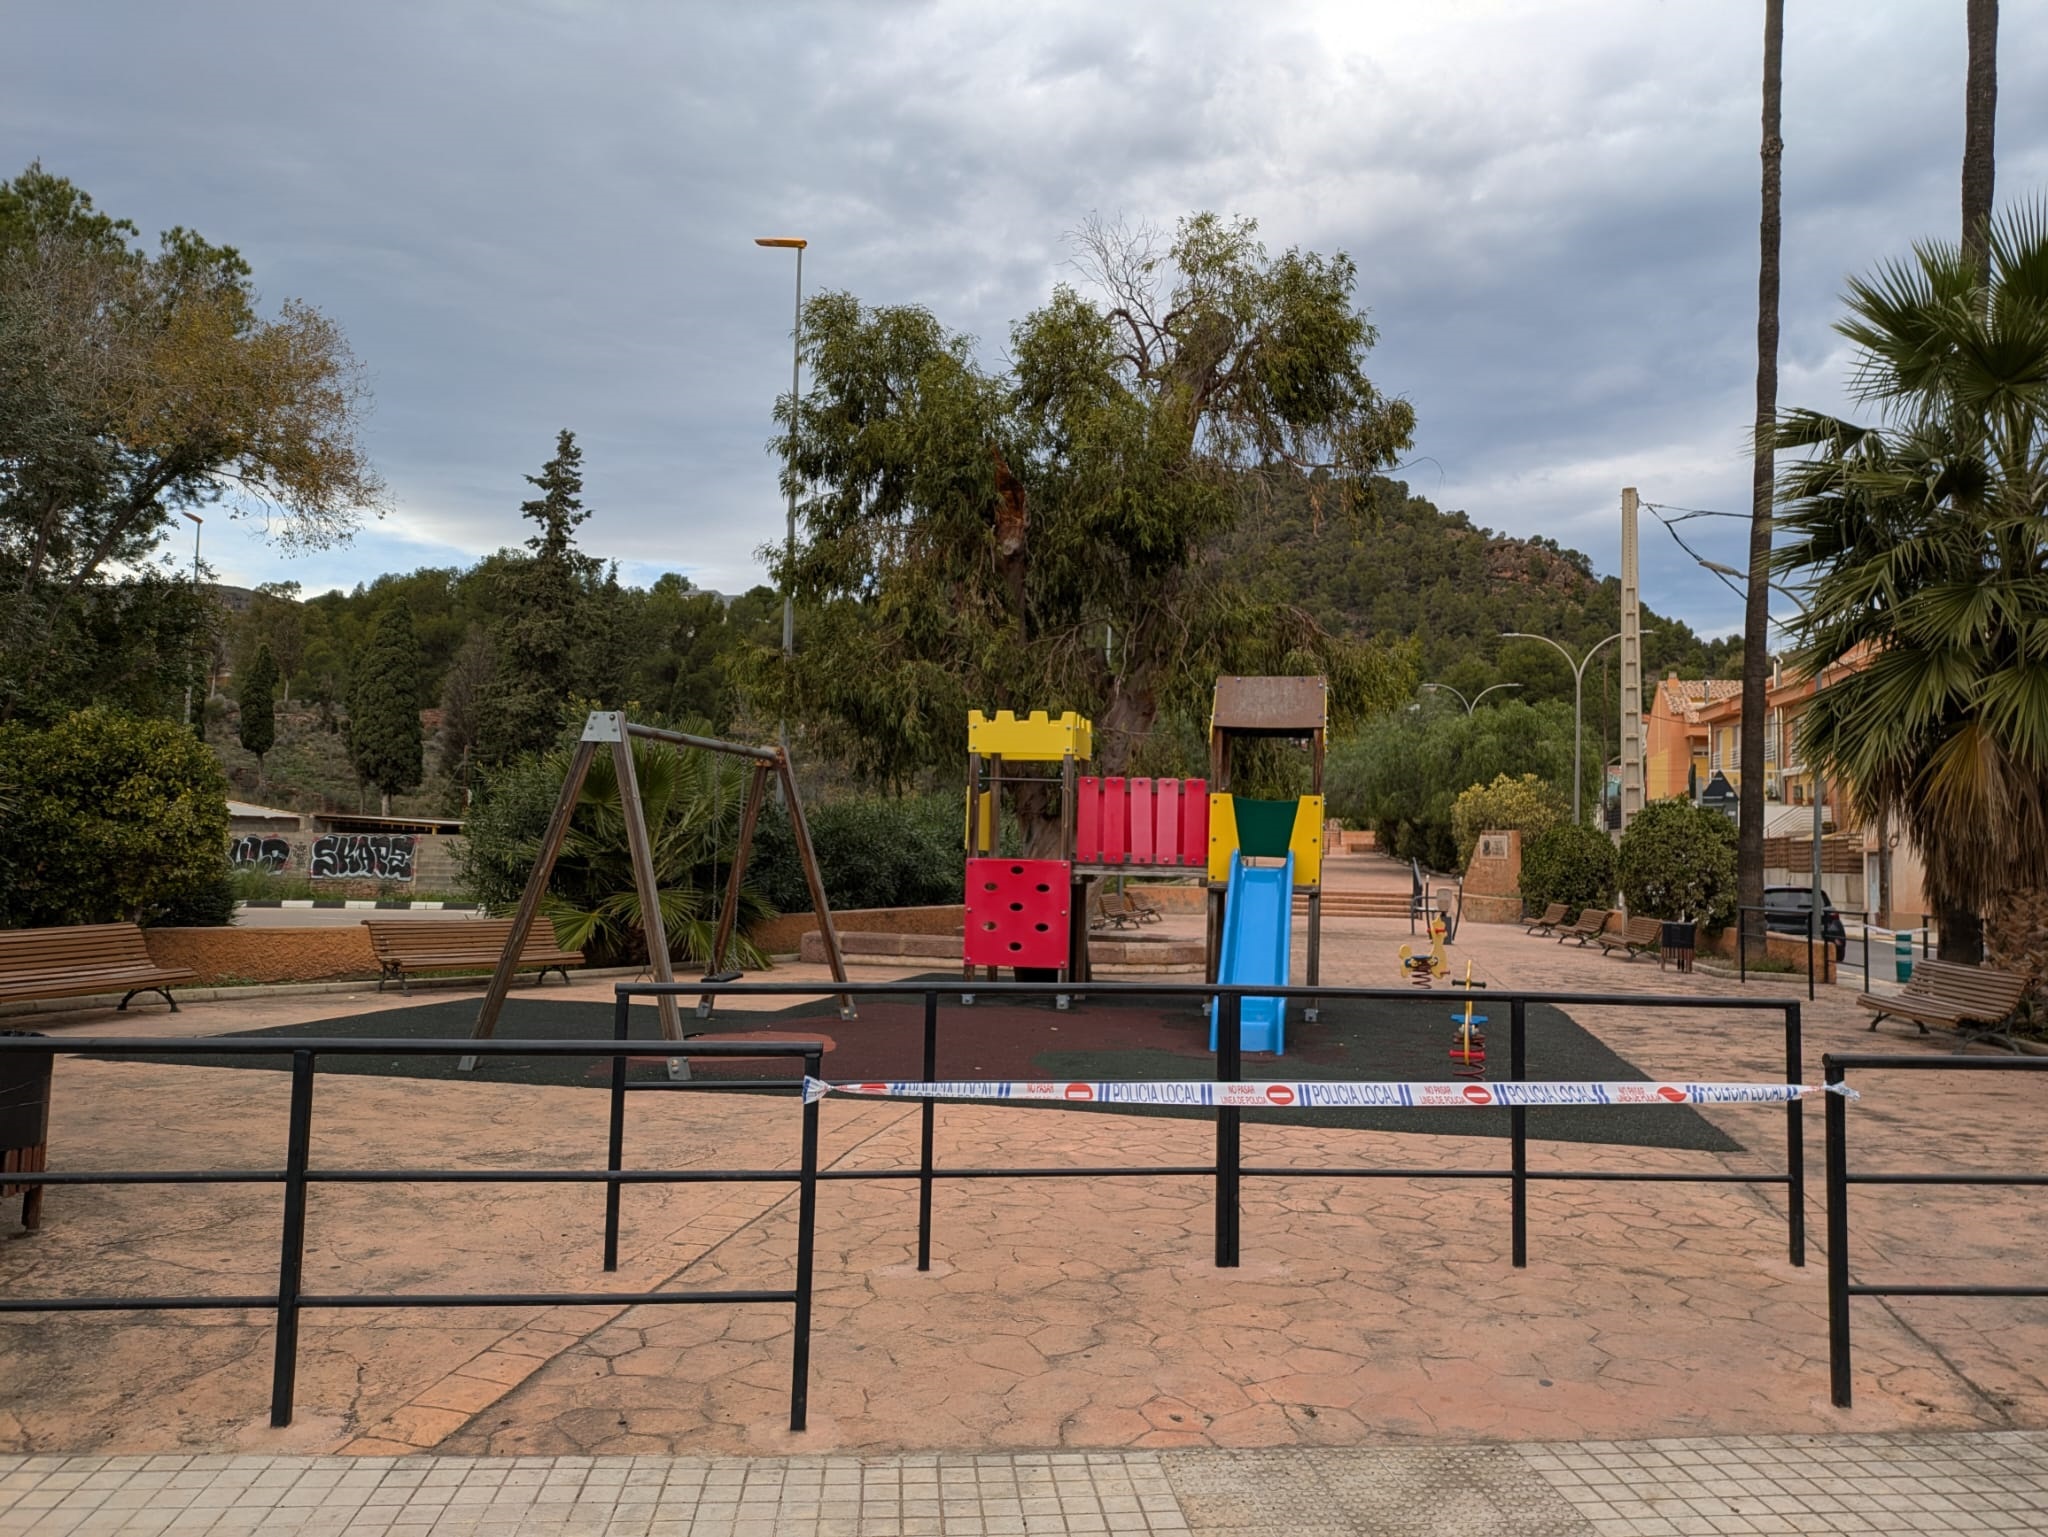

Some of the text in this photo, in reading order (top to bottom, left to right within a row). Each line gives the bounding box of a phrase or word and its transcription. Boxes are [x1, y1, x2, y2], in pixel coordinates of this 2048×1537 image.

[1113, 1084, 1200, 1103] POLICIA LOCAL
[1312, 1085, 1400, 1104] POLICIA LOCAL
[1507, 1085, 1557, 1103] POLICIA
[1553, 1085, 1597, 1102] LOCAL
